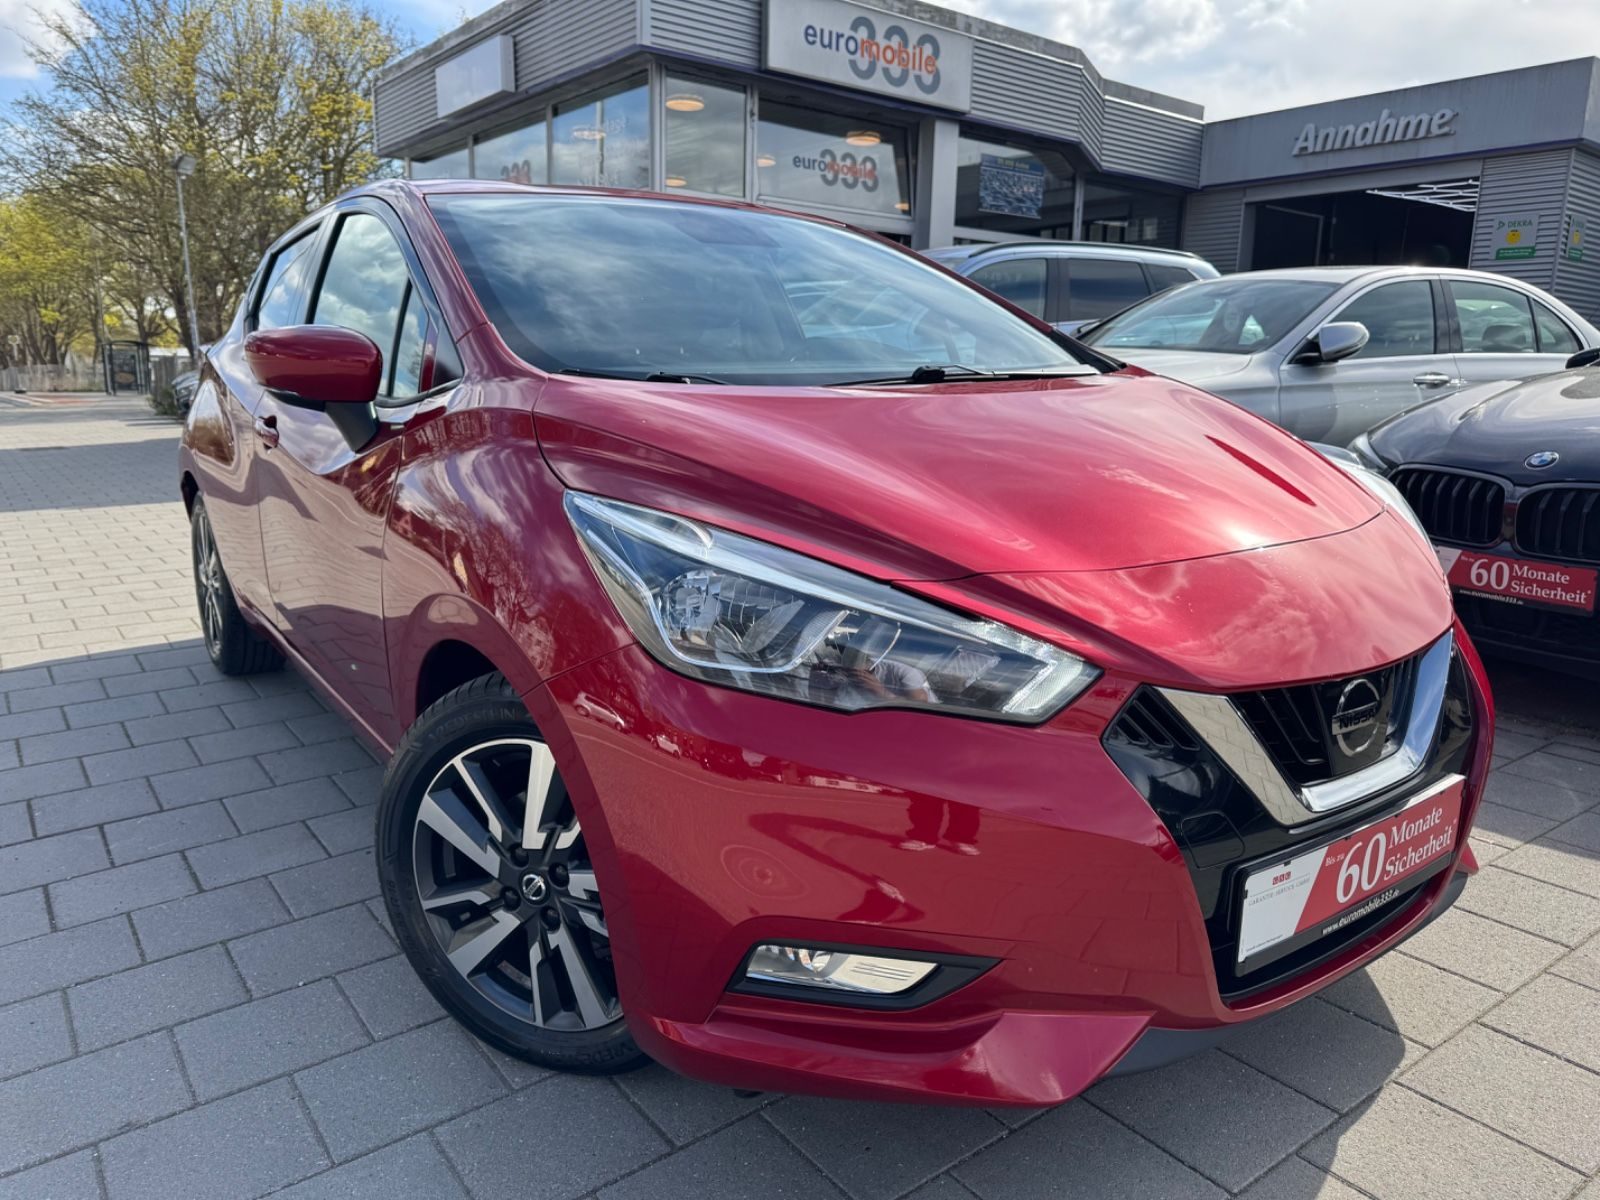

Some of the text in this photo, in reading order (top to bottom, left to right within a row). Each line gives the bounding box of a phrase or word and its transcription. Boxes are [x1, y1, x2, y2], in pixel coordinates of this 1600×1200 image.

[804, 16, 941, 95] euromobile 333
[1292, 108, 1458, 156] Annahme
[1507, 219, 1533, 228] DEKRA
[1470, 558, 1510, 590] 60
[1512, 564, 1570, 584] Monate
[1388, 807, 1443, 849] Monate
[1336, 832, 1387, 904] 60
